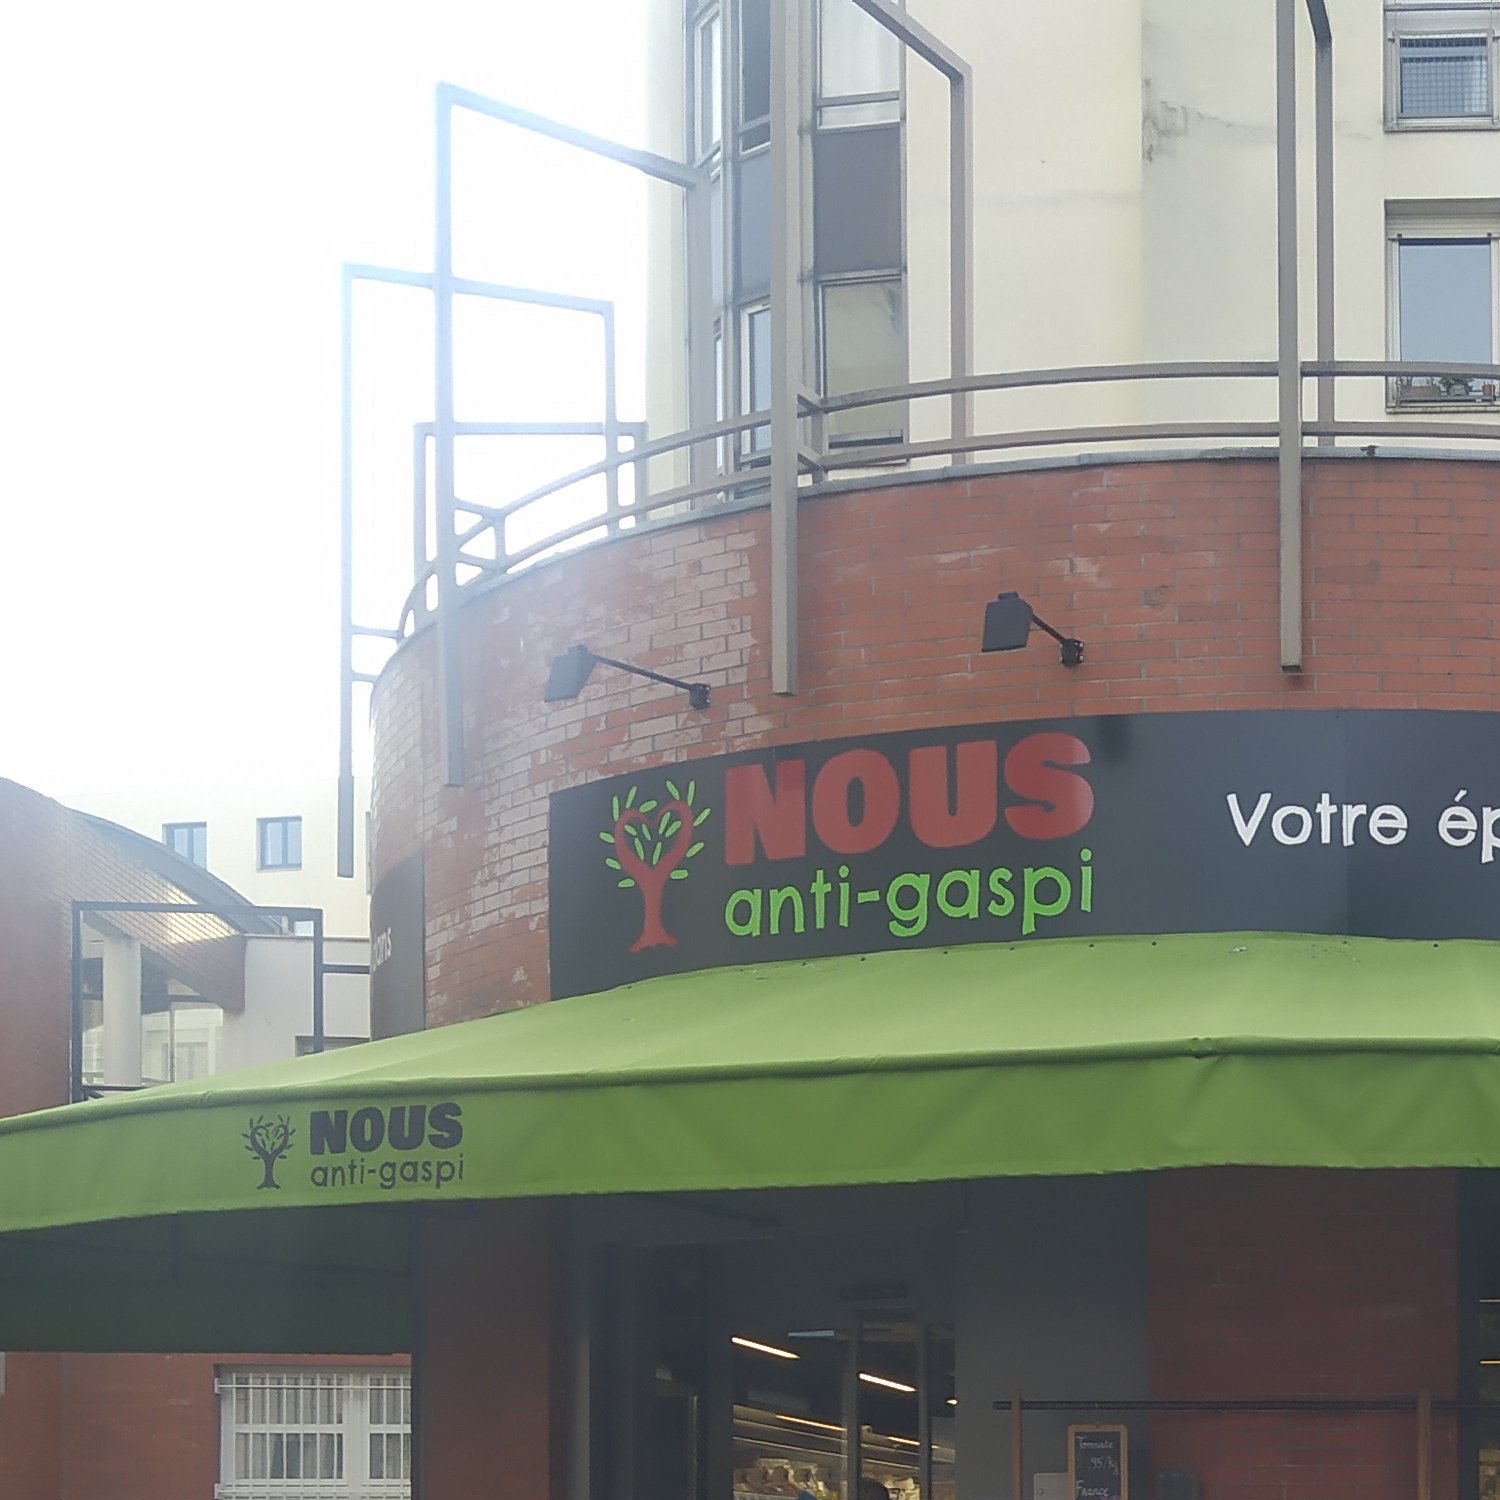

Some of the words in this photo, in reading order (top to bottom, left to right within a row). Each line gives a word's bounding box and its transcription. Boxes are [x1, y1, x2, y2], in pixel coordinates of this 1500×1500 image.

[725, 732, 1093, 866] NOUS
[1226, 792, 1408, 847] Votre
[725, 848, 1093, 937] anti-gaspi
[309, 1102, 463, 1155] NOUS
[310, 1153, 464, 1189] anti-gaspi
